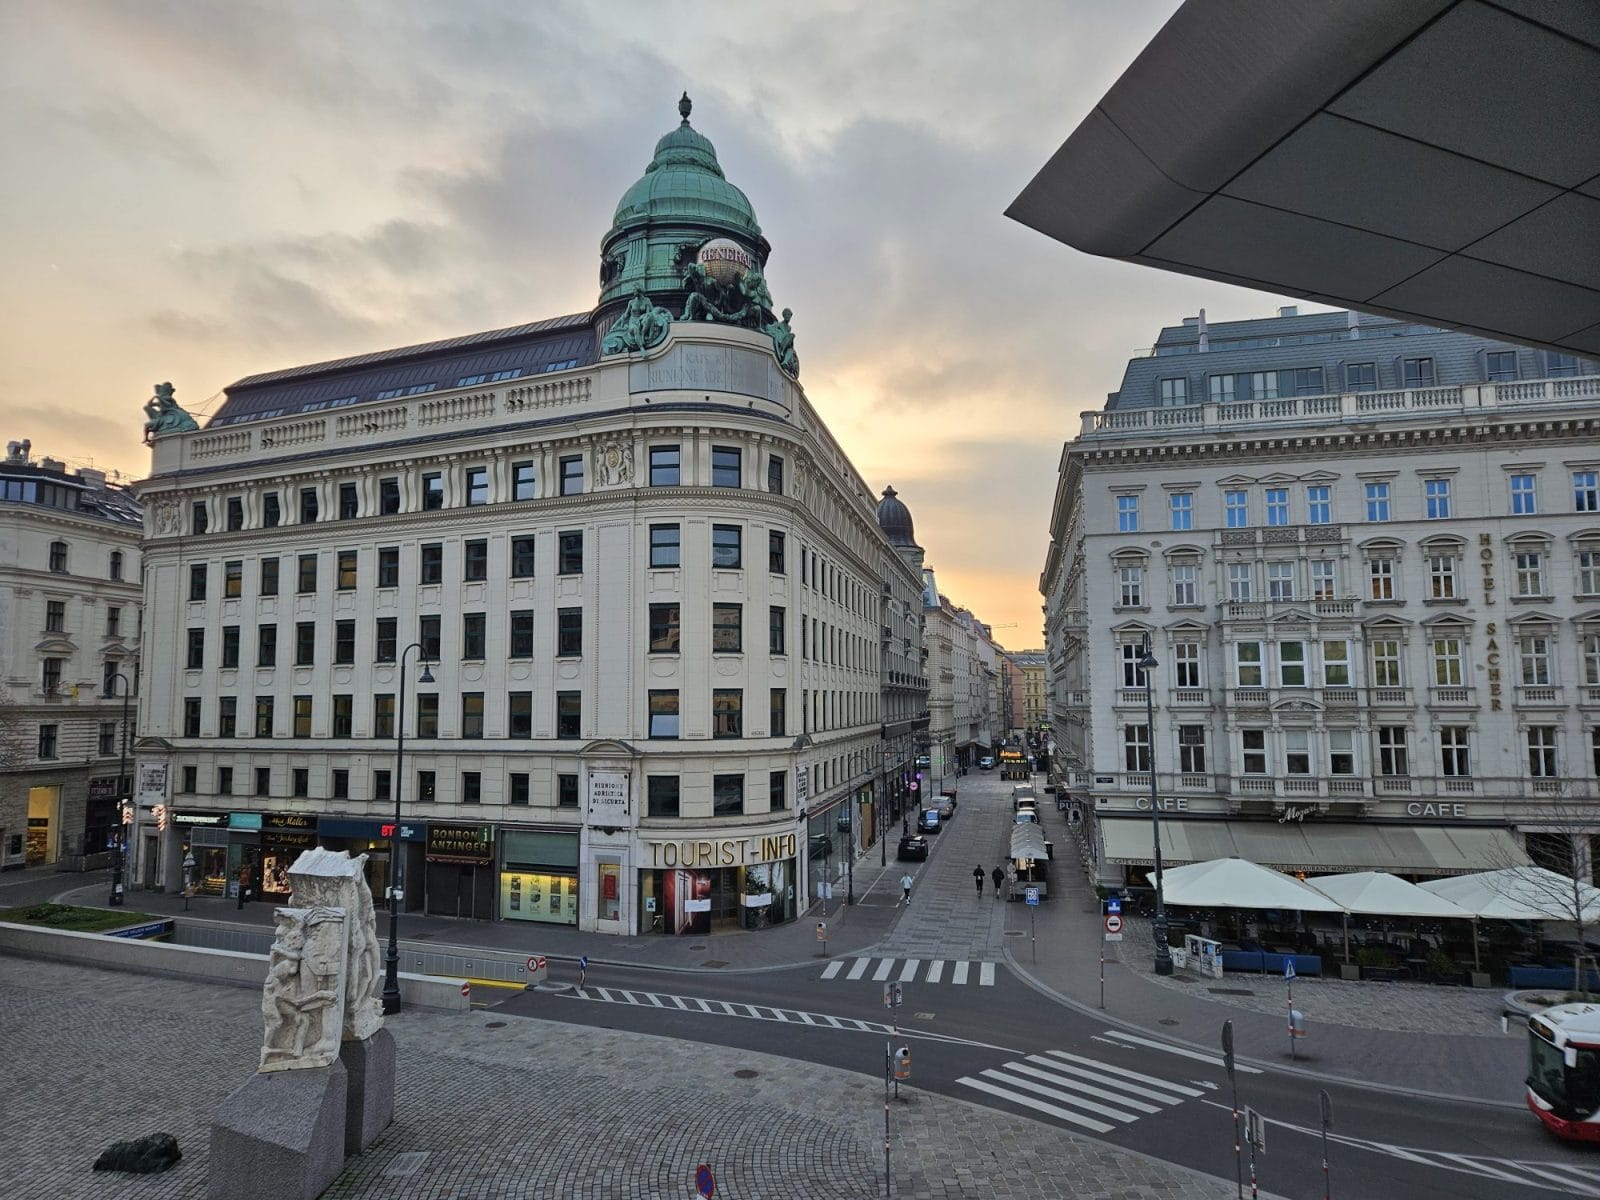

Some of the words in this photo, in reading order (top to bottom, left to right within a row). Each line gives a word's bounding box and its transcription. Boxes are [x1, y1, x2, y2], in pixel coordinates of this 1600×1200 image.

[1479, 534, 1496, 605] HOTEL
[1487, 623, 1503, 711] SACHER
[1406, 802, 1466, 818] CAFE
[432, 829, 479, 840] BONBON
[430, 840, 487, 852] ANZINGER
